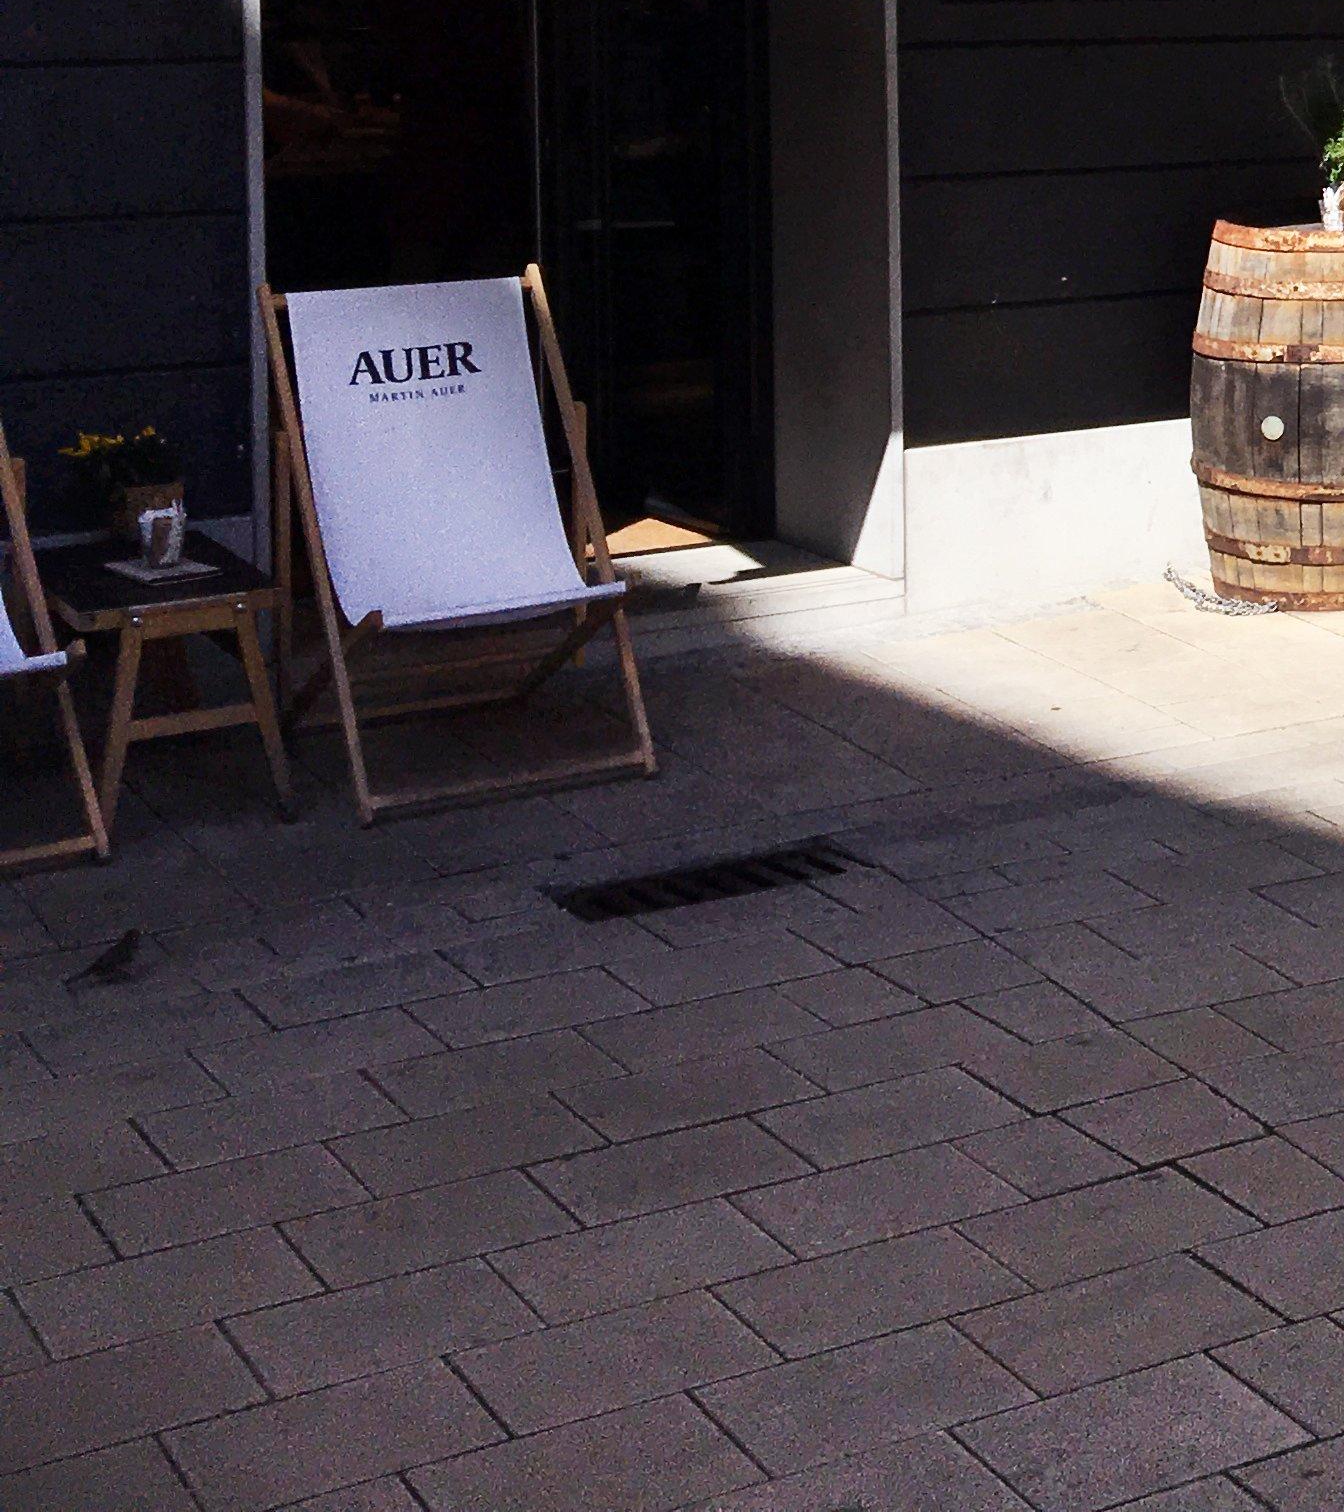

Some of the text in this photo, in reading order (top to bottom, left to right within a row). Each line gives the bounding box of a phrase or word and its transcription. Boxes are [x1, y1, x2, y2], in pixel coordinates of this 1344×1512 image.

[349, 341, 482, 386] AUER
[369, 384, 466, 403] MARTIN AUER
